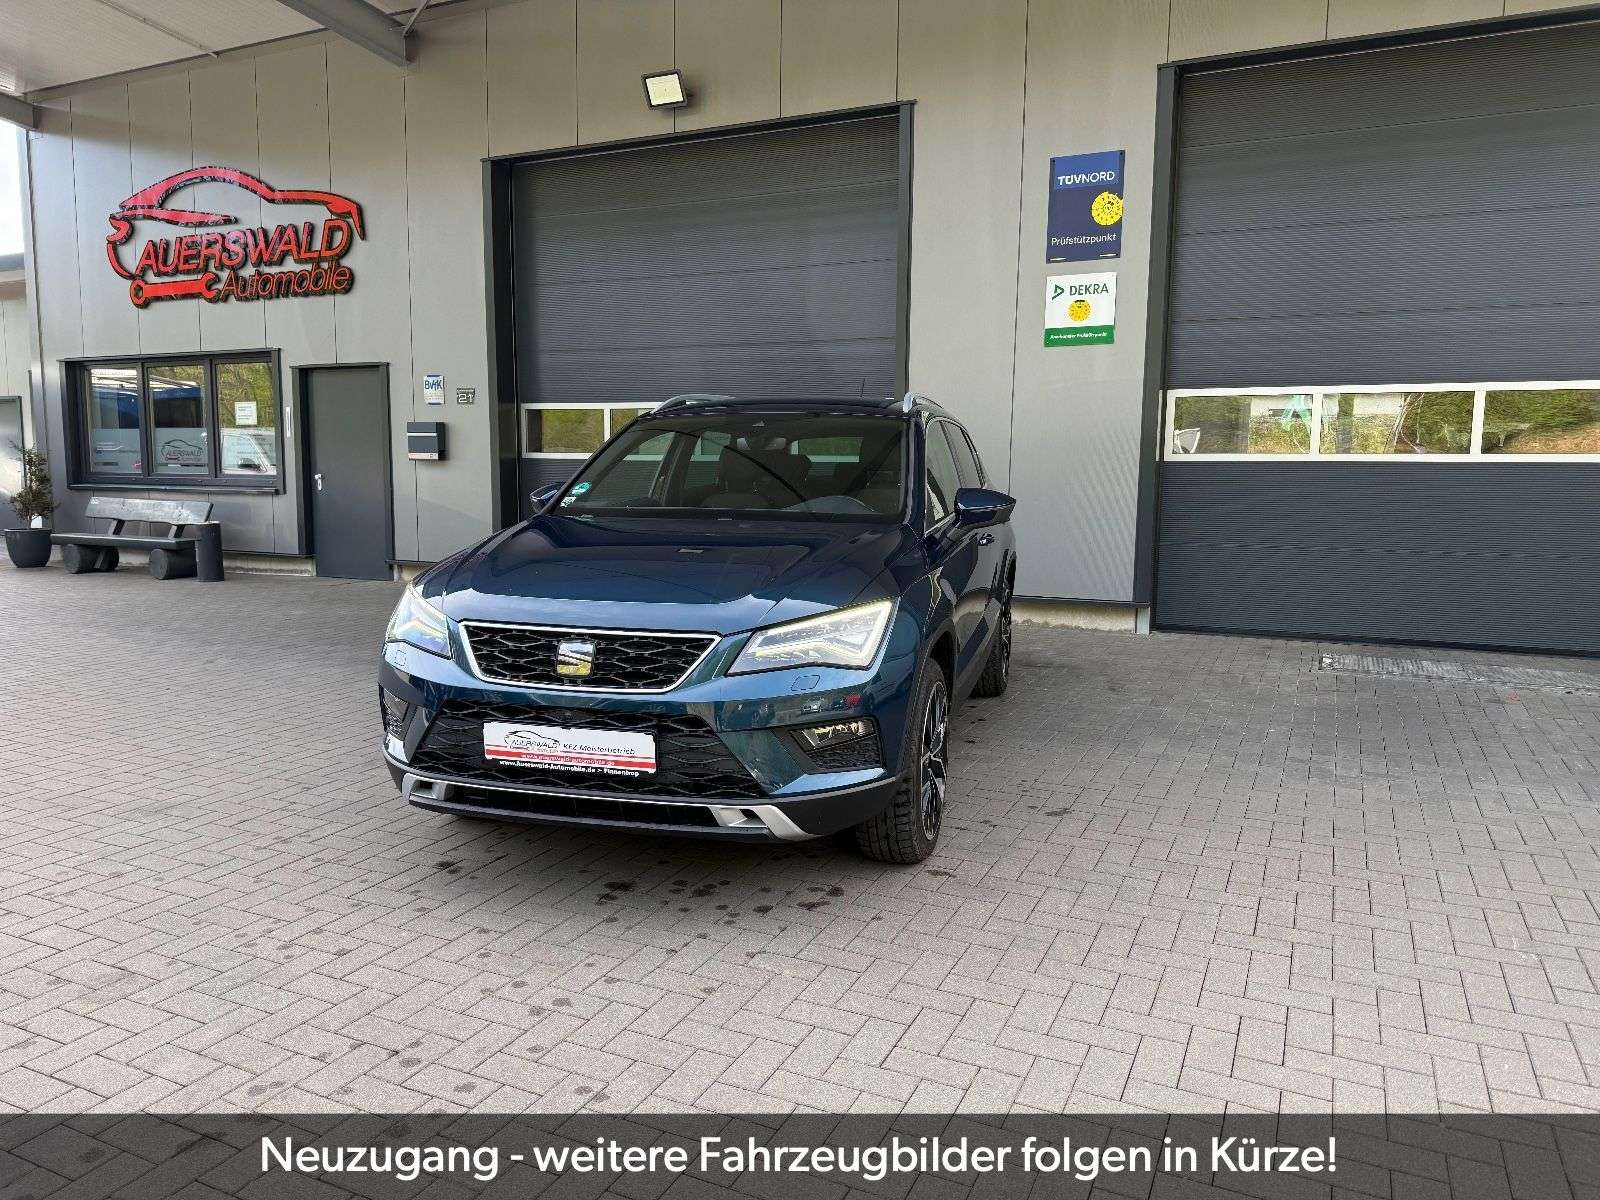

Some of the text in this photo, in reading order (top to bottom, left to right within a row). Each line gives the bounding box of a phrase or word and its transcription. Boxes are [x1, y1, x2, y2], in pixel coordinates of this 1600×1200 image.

[1051, 233, 1116, 246] Prüfstützpunkt
[135, 218, 353, 277] AUERSWALD
[219, 261, 352, 301] Automobile
[1069, 283, 1109, 296] DEKRA
[458, 393, 473, 403] 21
[563, 743, 578, 751] KFZ
[579, 744, 636, 755] Meisterbetrieb
